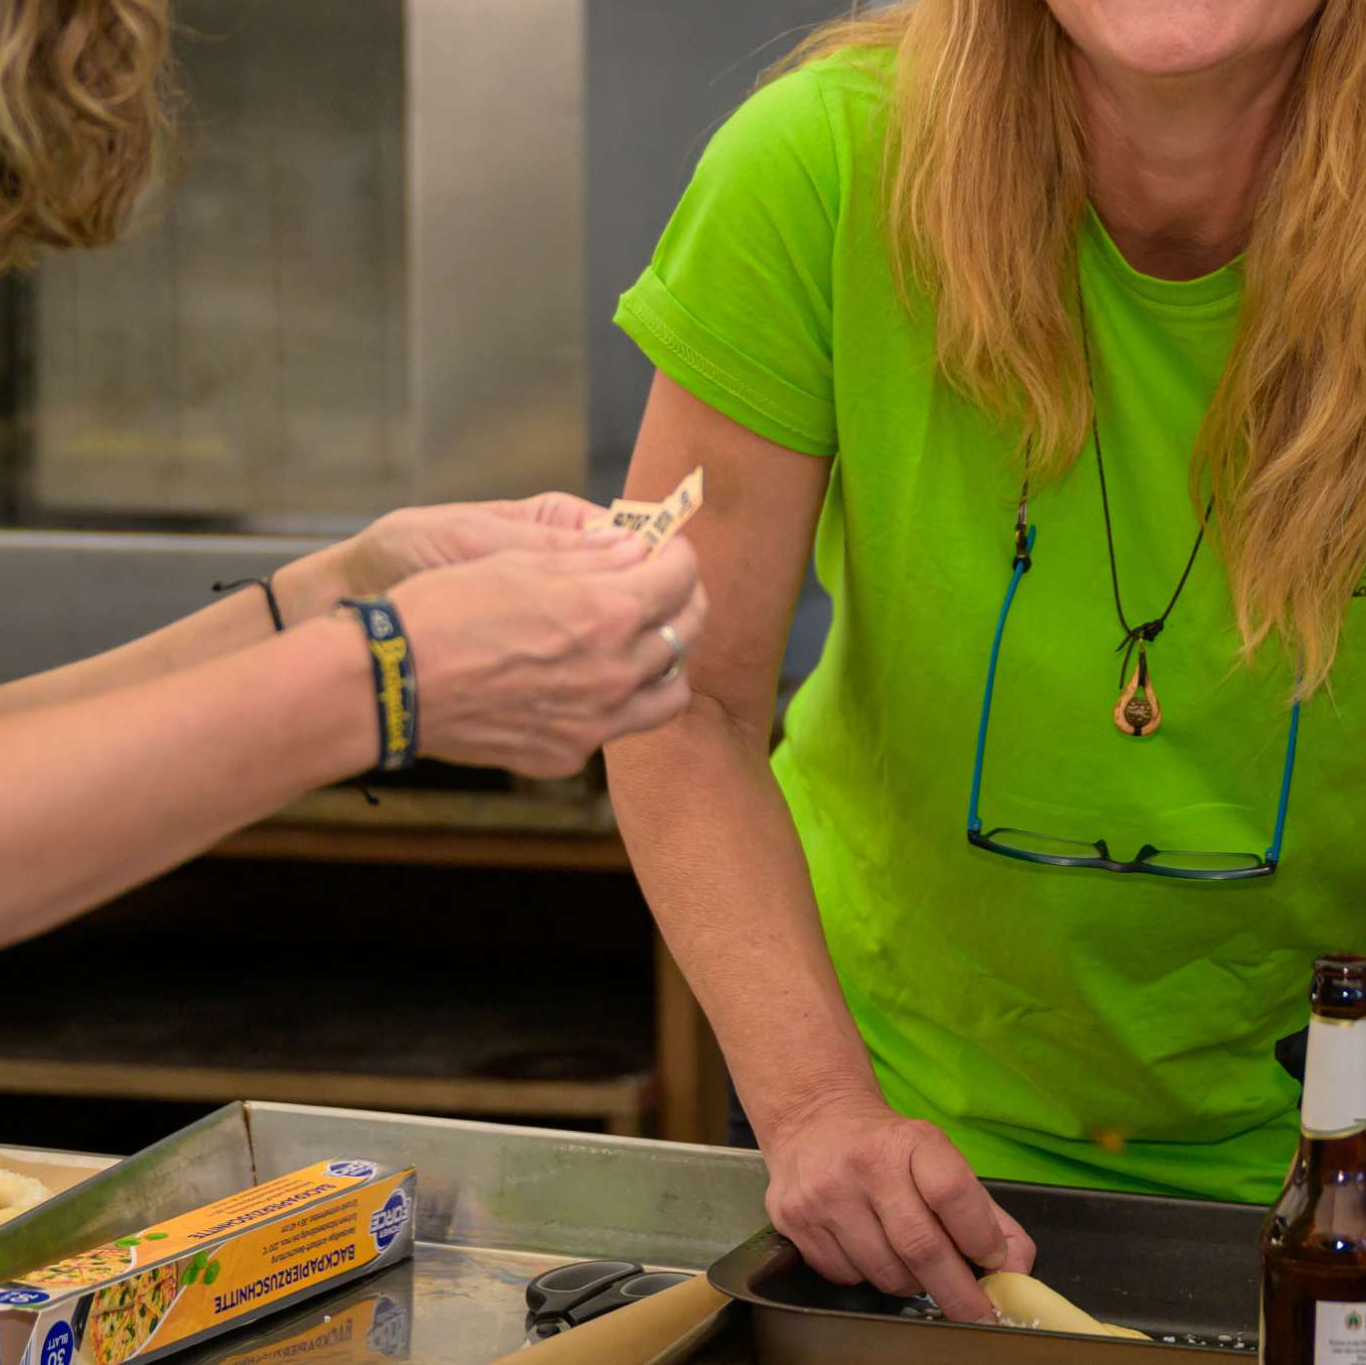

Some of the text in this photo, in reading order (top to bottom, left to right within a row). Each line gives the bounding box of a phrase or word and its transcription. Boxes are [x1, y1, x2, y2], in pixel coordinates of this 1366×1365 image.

[213, 1243, 357, 1315] BACKPAPIERZUSCHNITTE
[47, 1332, 70, 1351] BLATT
[46, 1347, 67, 1365] 30
